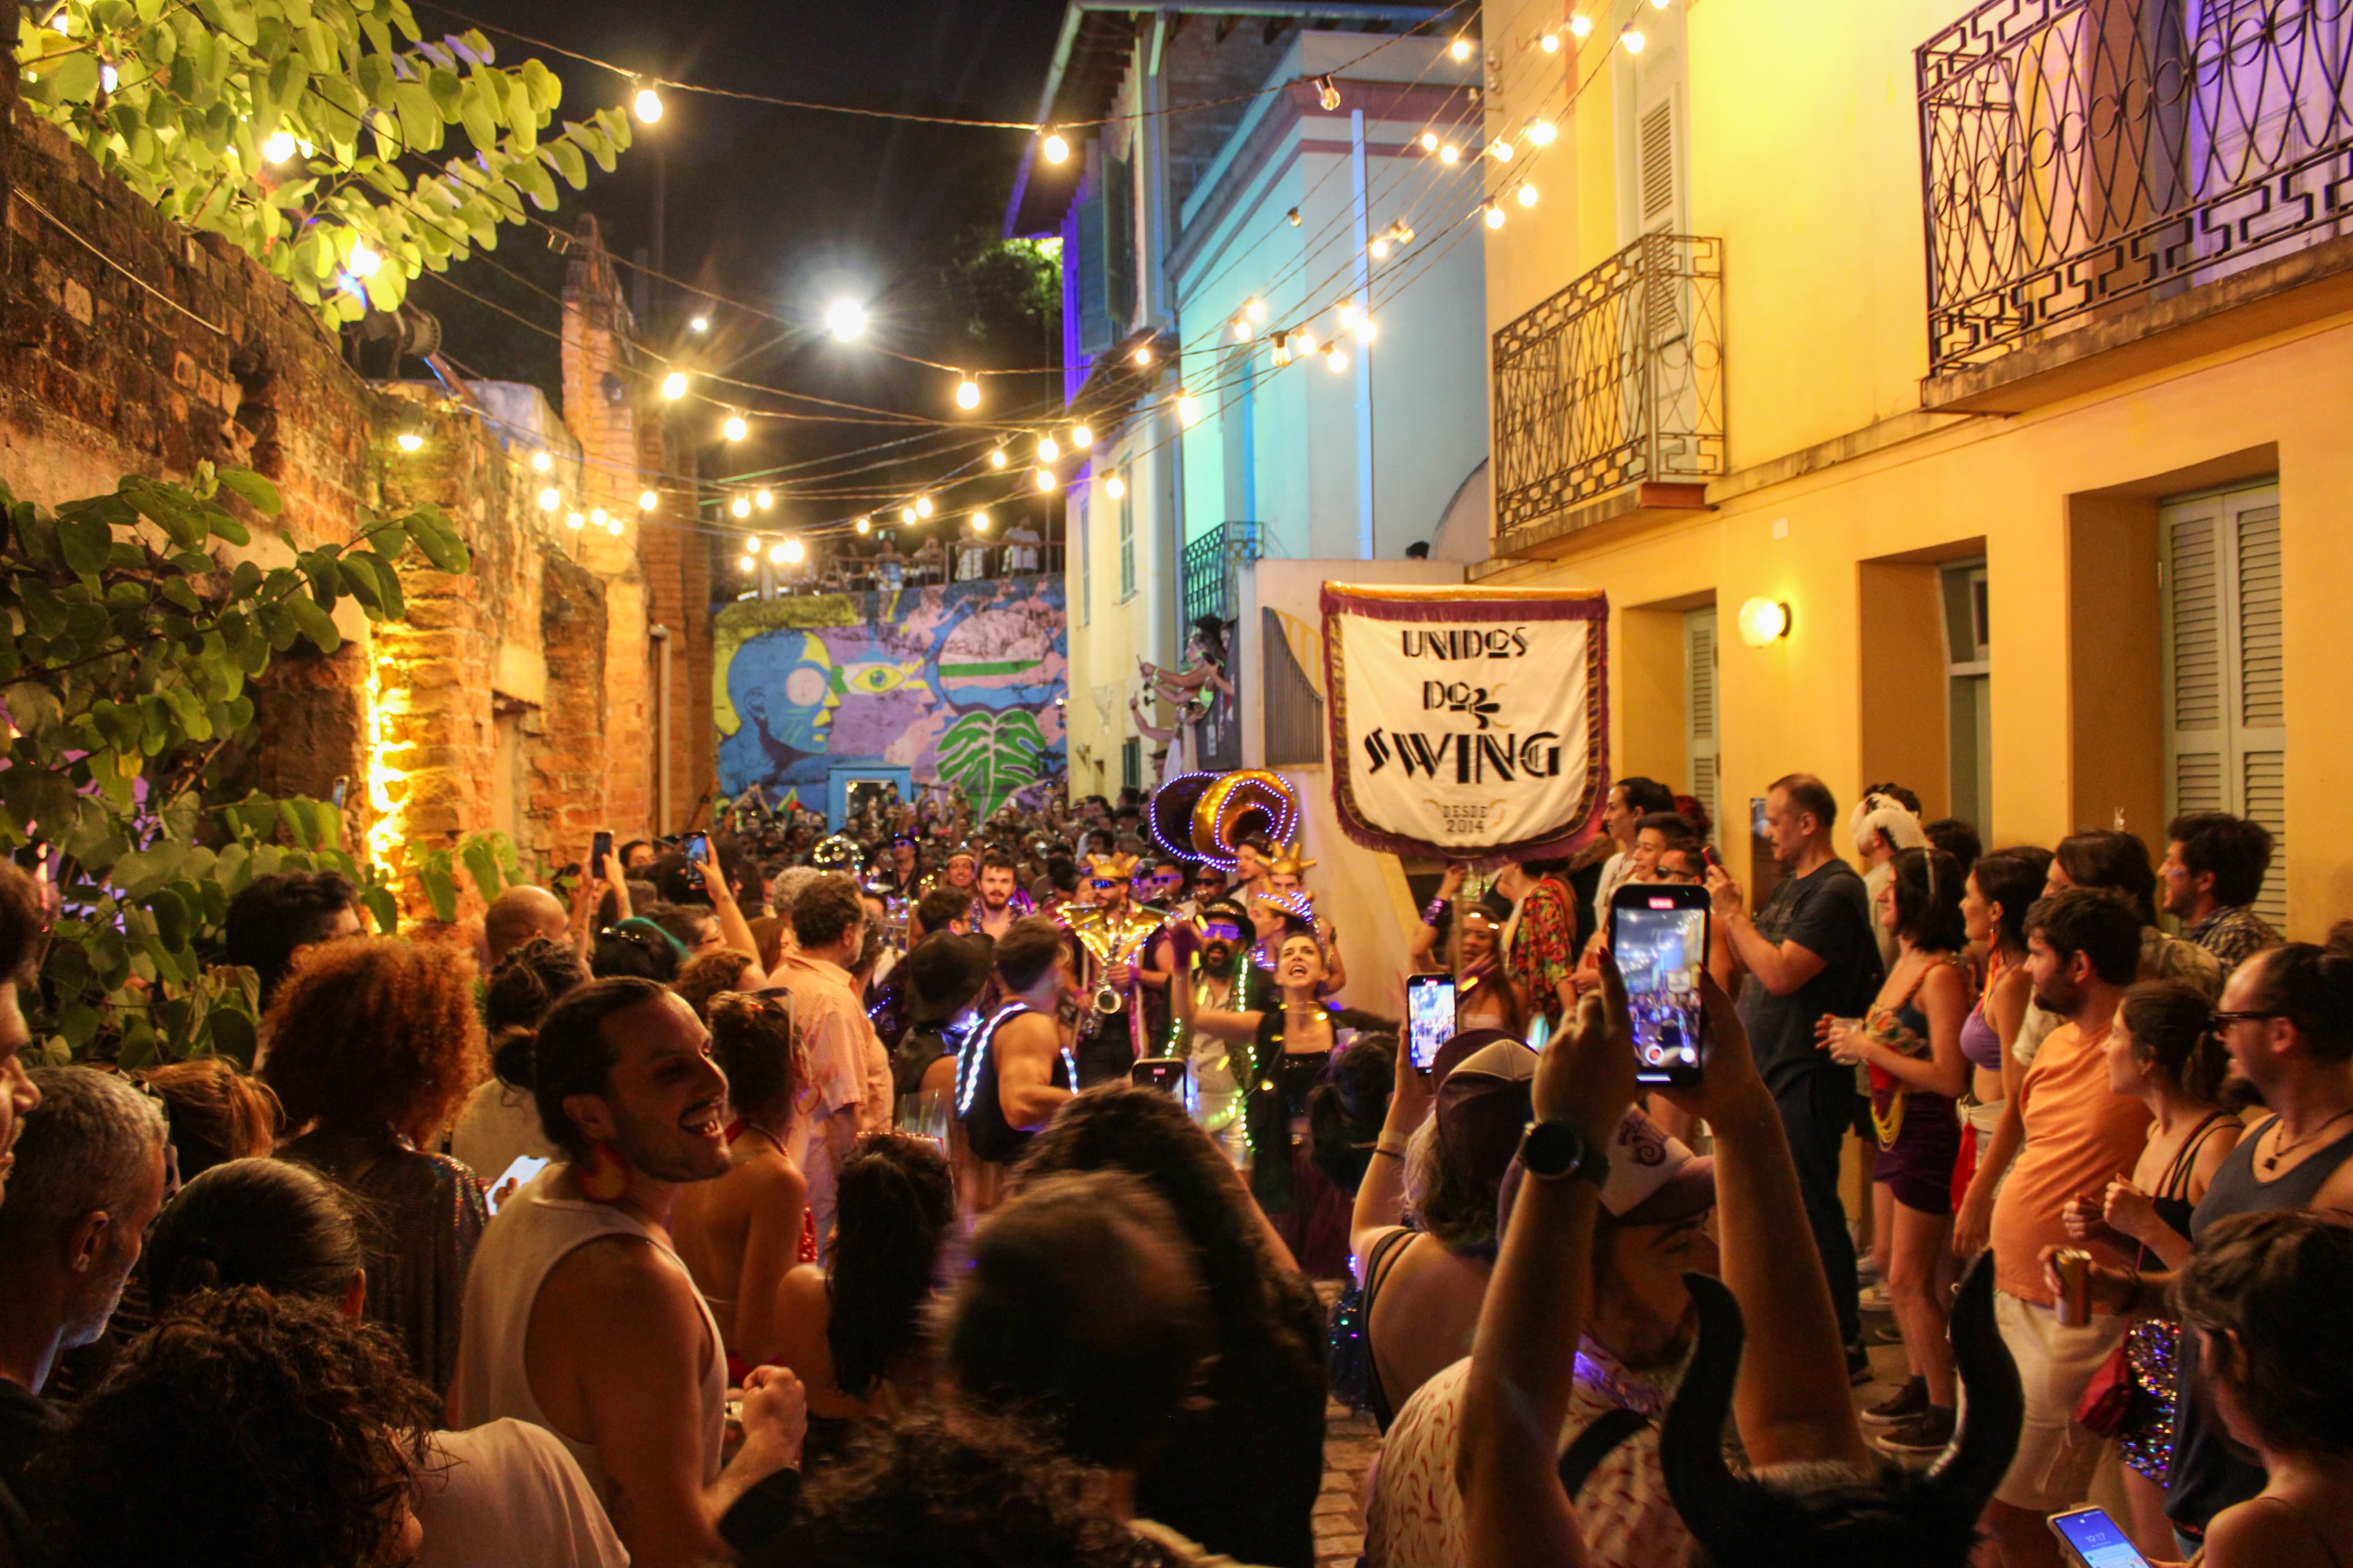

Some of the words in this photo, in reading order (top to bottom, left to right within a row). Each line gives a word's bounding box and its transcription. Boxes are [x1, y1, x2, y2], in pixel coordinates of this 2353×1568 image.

[1403, 627, 1528, 660] UNIDOS
[1424, 680, 1469, 712] DO
[1364, 727, 1560, 784] SWING
[1443, 805, 1487, 818] DESDE
[1447, 819, 1484, 833] 2014
